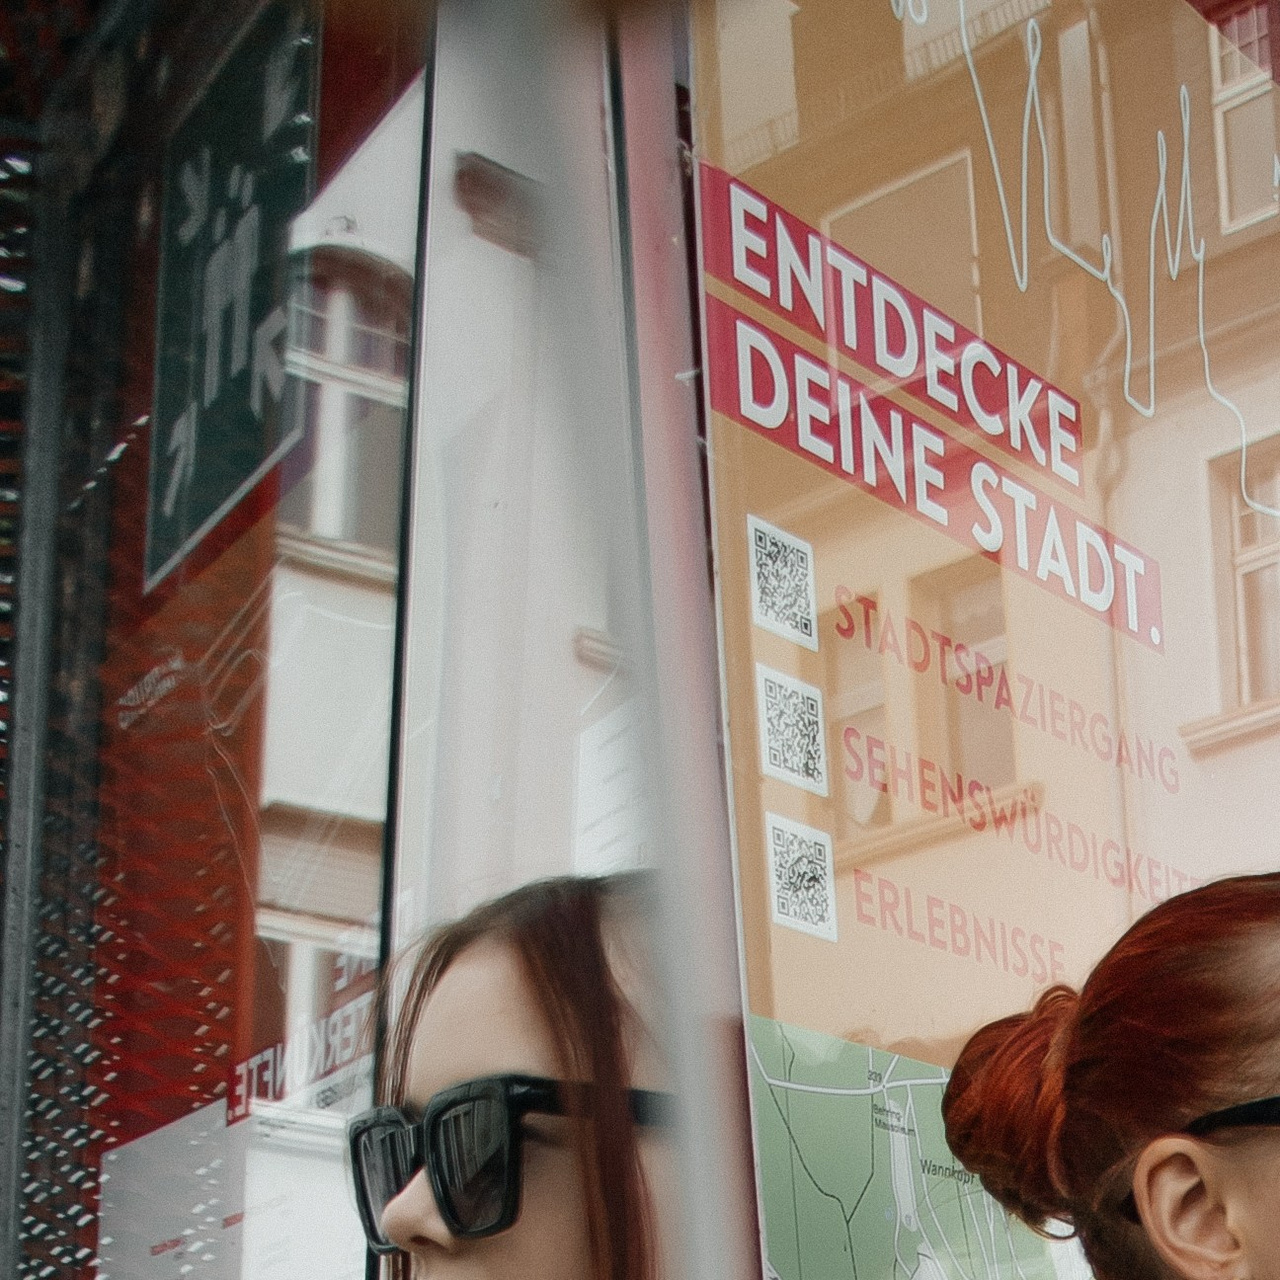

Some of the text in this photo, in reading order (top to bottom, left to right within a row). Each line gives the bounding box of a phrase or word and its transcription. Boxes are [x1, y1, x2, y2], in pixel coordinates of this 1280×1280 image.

[728, 180, 1082, 489] ENTDECKE
[734, 317, 1162, 646] DEINE STADT.
[834, 585, 1181, 795] STADTSPAZIERGANG
[842, 725, 1204, 905] SEHENSWÜRDIGKEIT
[853, 869, 1067, 985] ERLEBNISSE
[920, 1158, 976, 1186] Wannkopf
